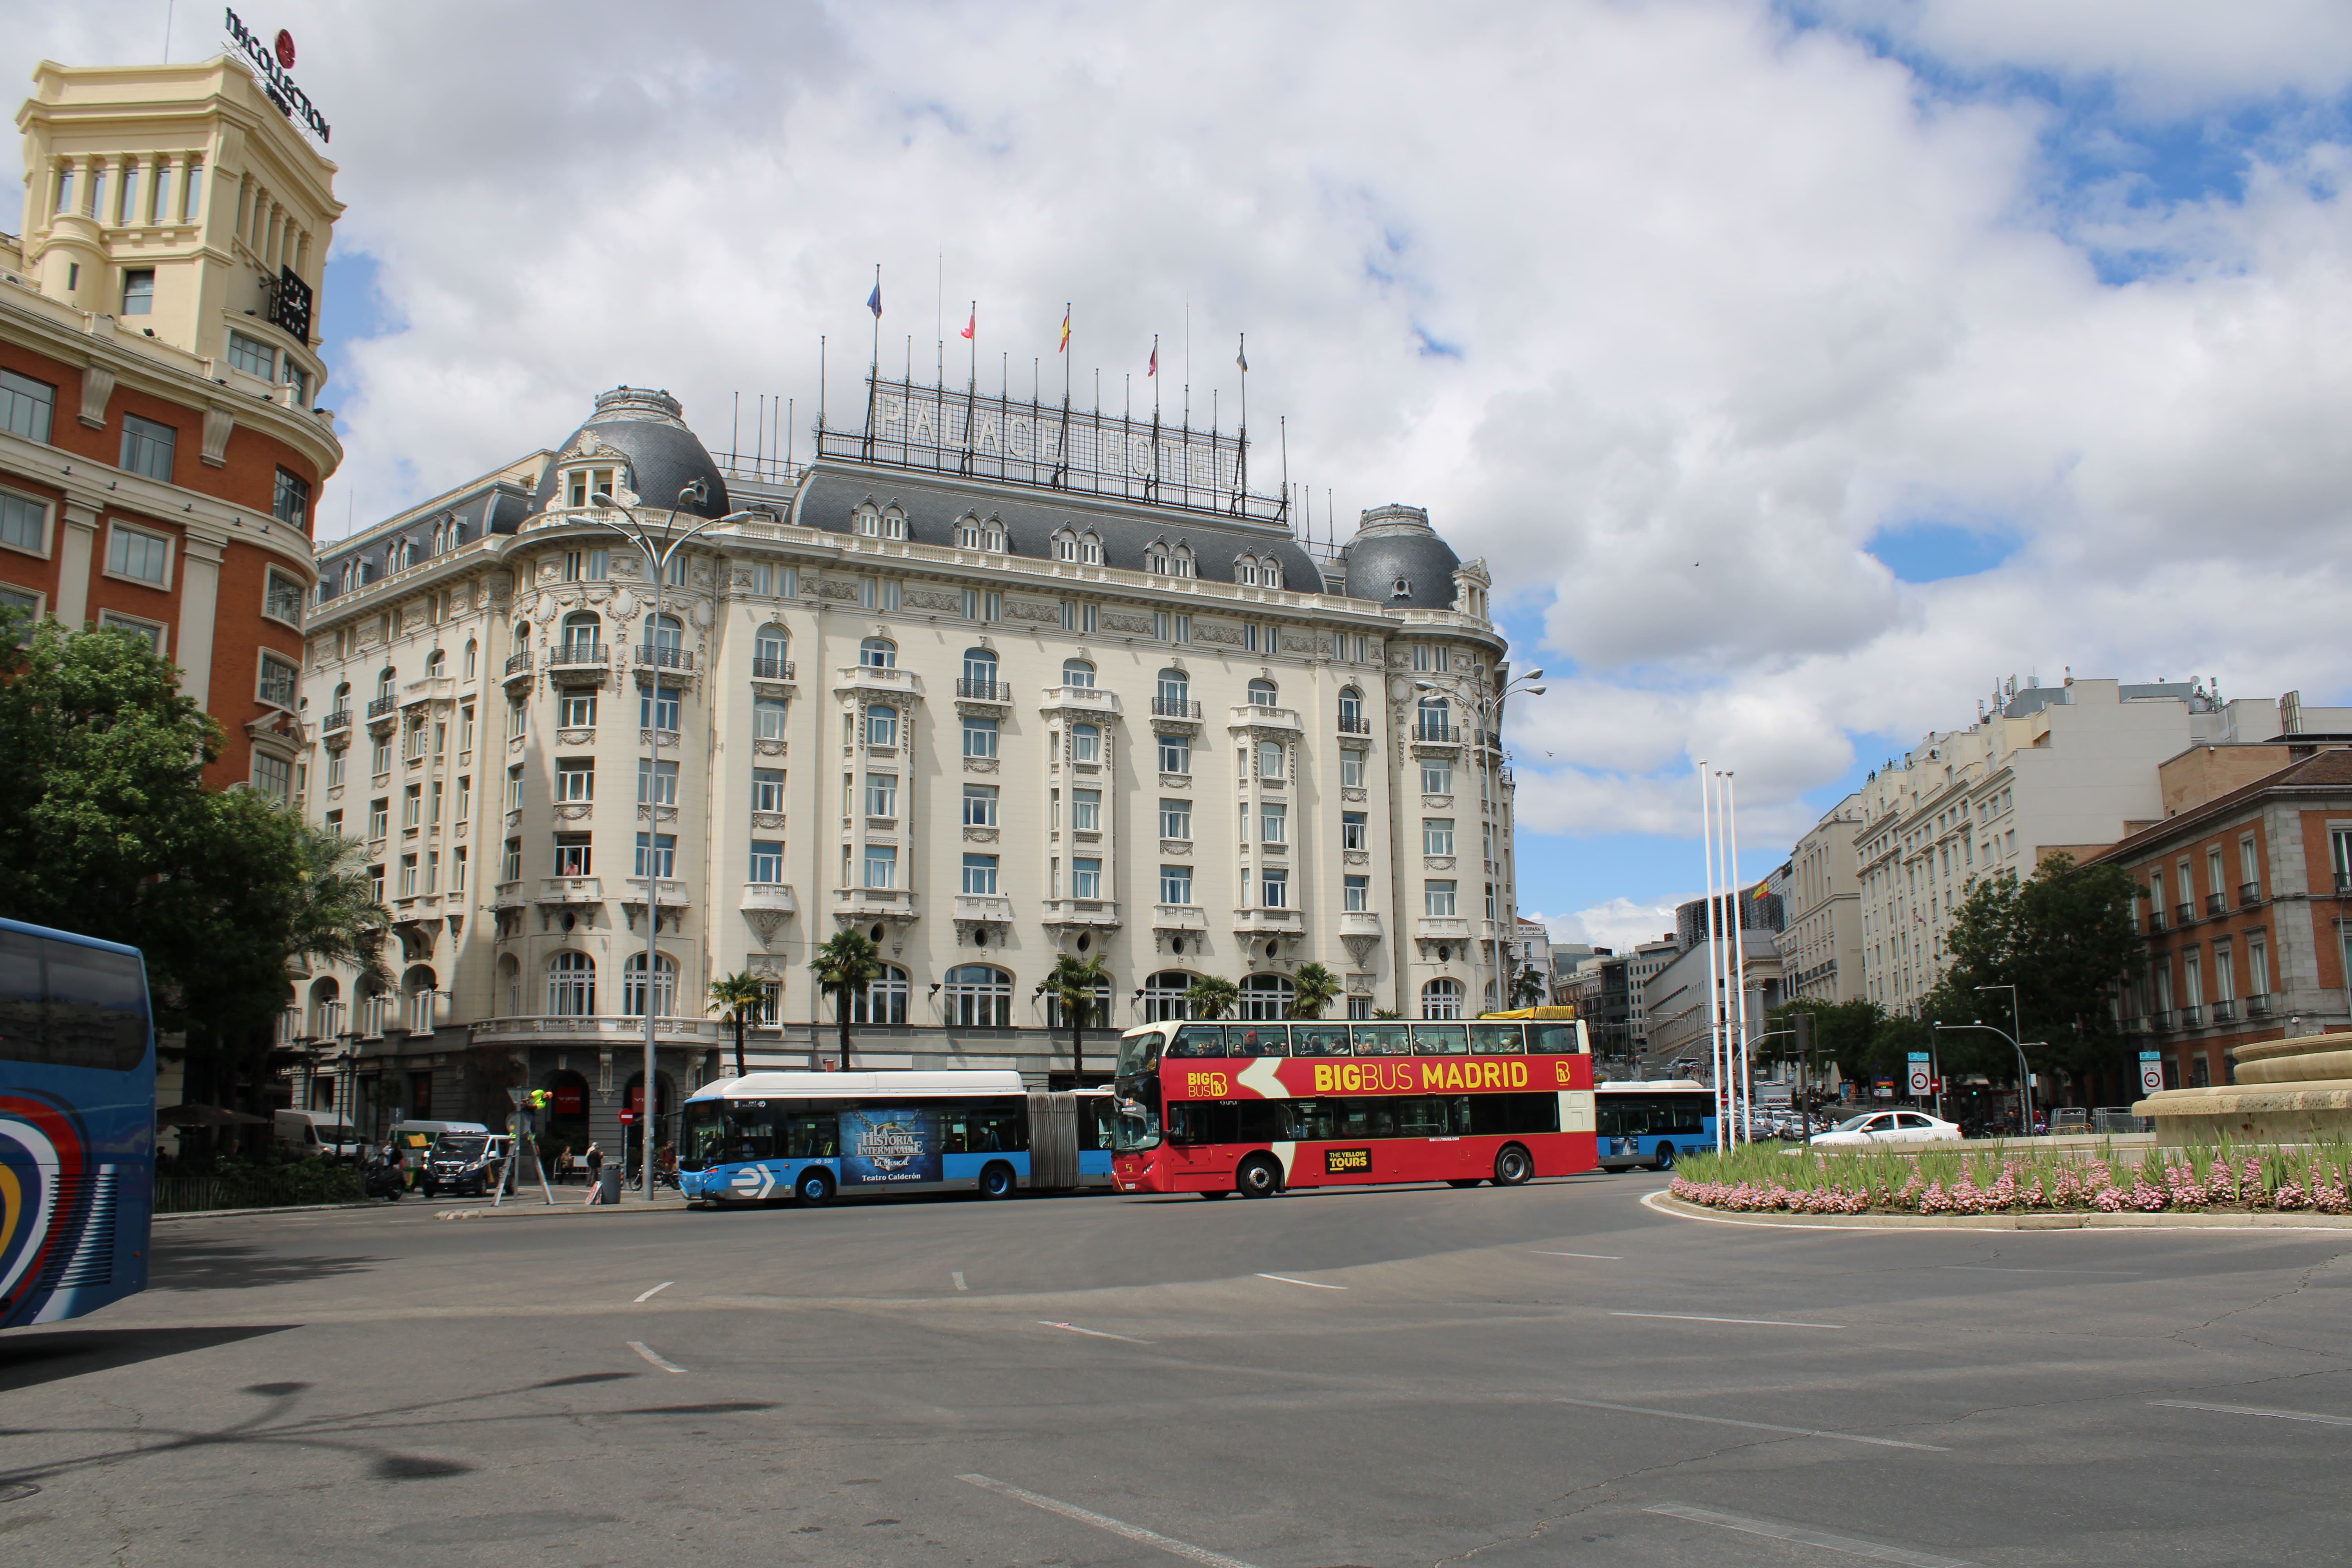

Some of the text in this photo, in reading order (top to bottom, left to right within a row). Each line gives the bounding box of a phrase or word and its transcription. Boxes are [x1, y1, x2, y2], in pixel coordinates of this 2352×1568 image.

[879, 395, 1240, 492] PALACE HOTEL
[1188, 1073, 1210, 1085] BIG
[1422, 1062, 1528, 1089] MADRID
[1188, 1085, 1211, 1097] BUS
[873, 1125, 889, 1136] LA
[861, 1131, 914, 1146] HISTORIA
[857, 1141, 924, 1155] INTERMINABLE
[1329, 1157, 1367, 1167] TOURS
